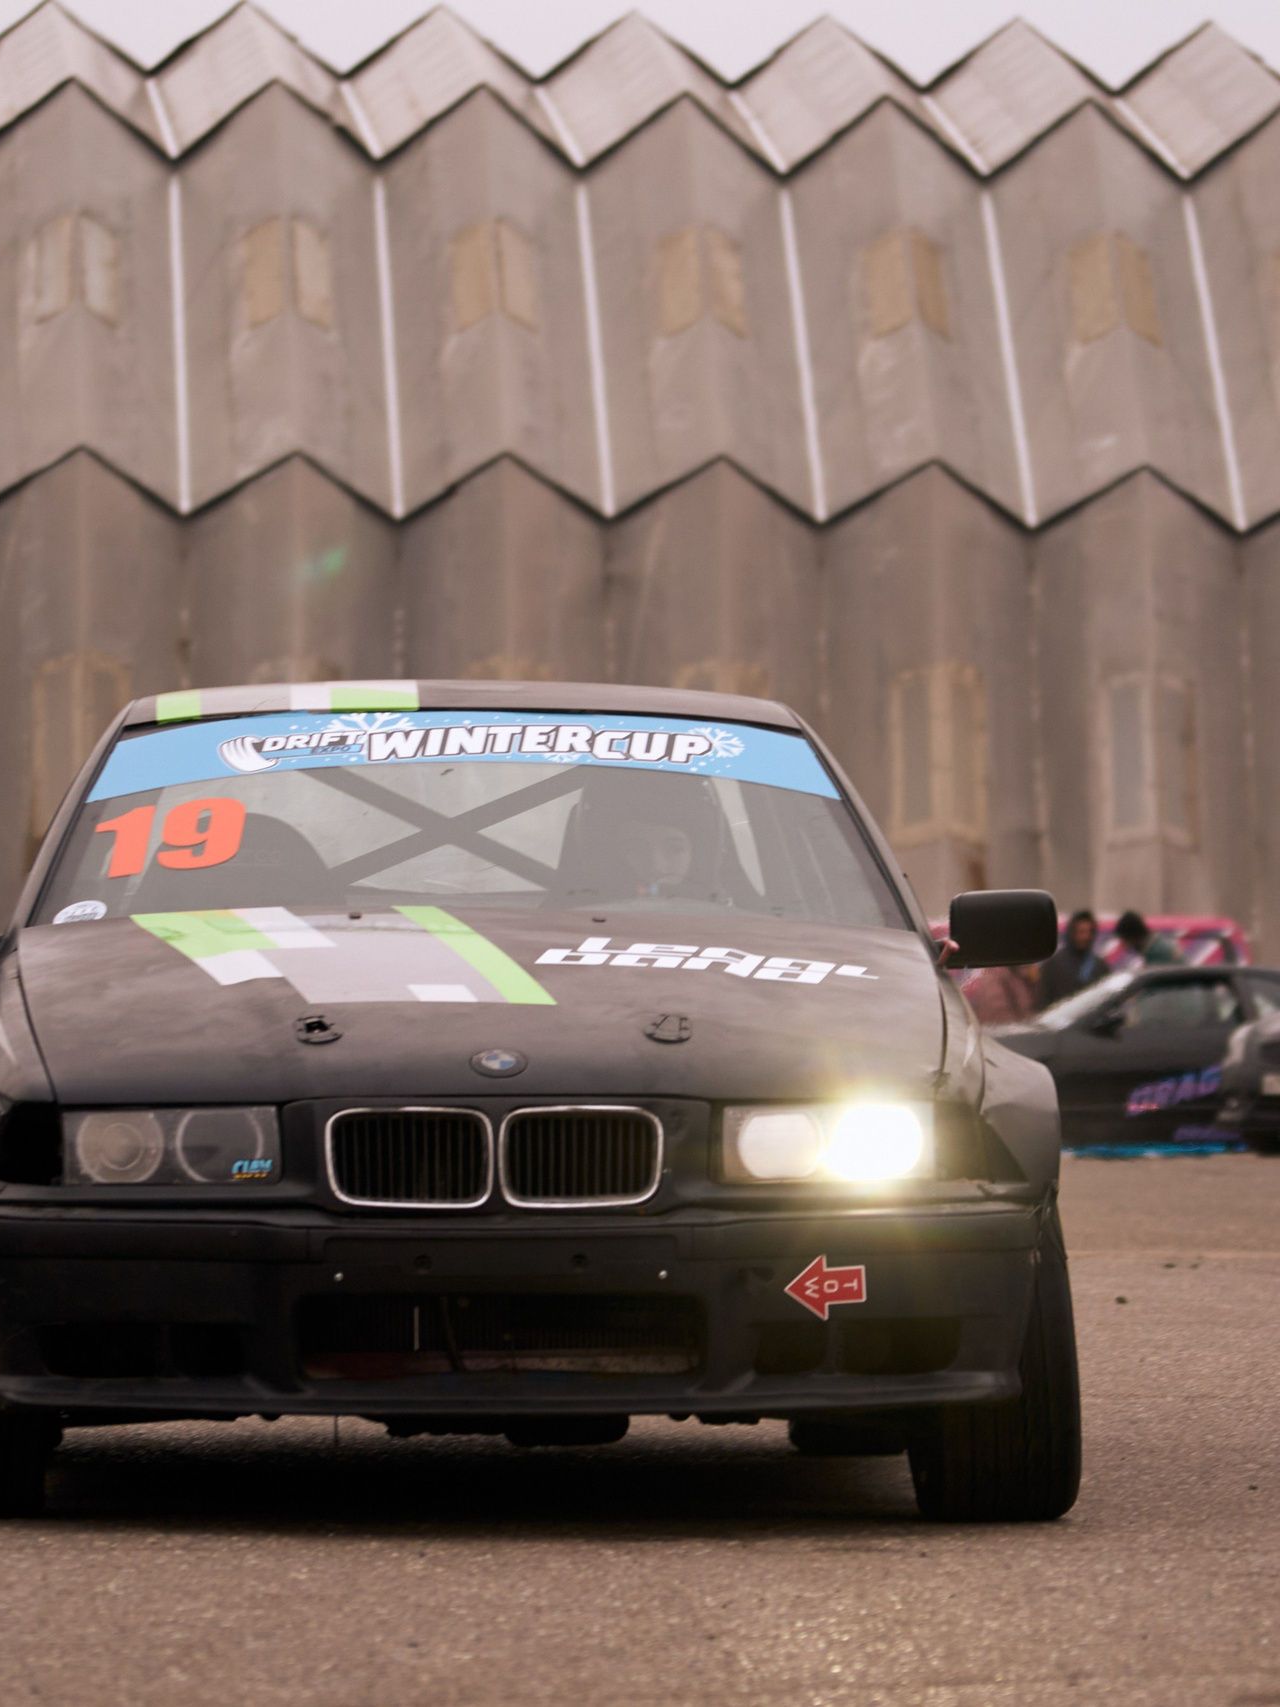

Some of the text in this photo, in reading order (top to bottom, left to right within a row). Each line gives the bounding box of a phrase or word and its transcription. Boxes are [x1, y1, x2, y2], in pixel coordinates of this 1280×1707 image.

[262, 730, 366, 752] DRIFT
[95, 797, 247, 879] 19
[804, 1276, 859, 1299] TOW
